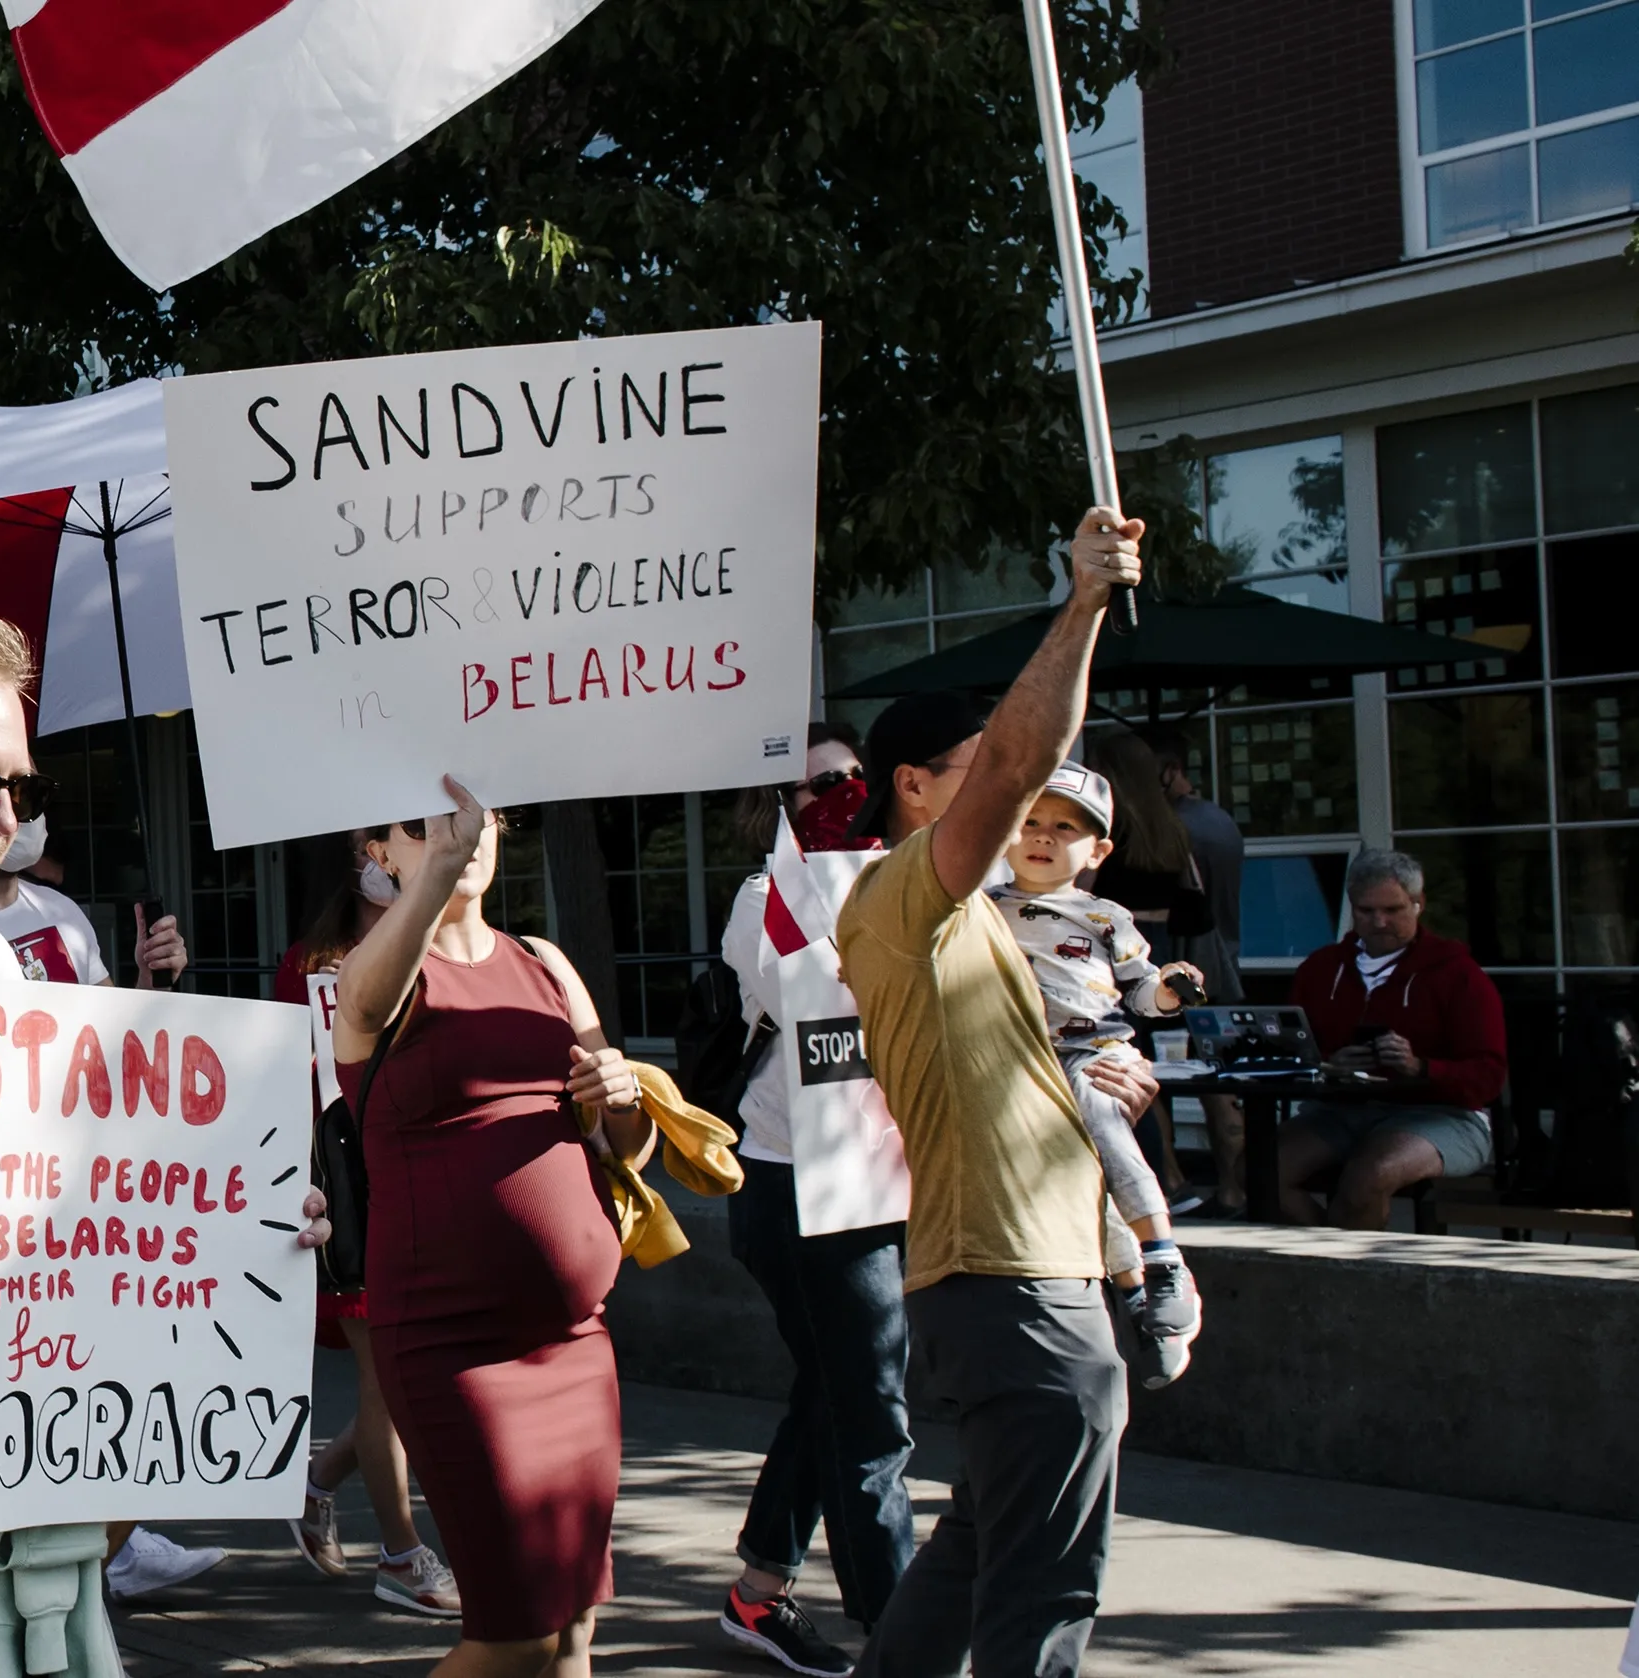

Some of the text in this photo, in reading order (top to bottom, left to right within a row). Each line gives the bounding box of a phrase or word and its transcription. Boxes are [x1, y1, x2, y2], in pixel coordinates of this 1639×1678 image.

[334, 474, 658, 557] SUPPORTS
[200, 577, 461, 674] TERROR
[472, 567, 501, 624] &
[463, 640, 747, 724] BELARUS
[807, 1031, 855, 1066] STOP
[0, 1151, 62, 1200] THE
[91, 1155, 248, 1213] PEOPLE
[112, 1271, 218, 1309] FIGHT
[7, 1306, 95, 1382] for
